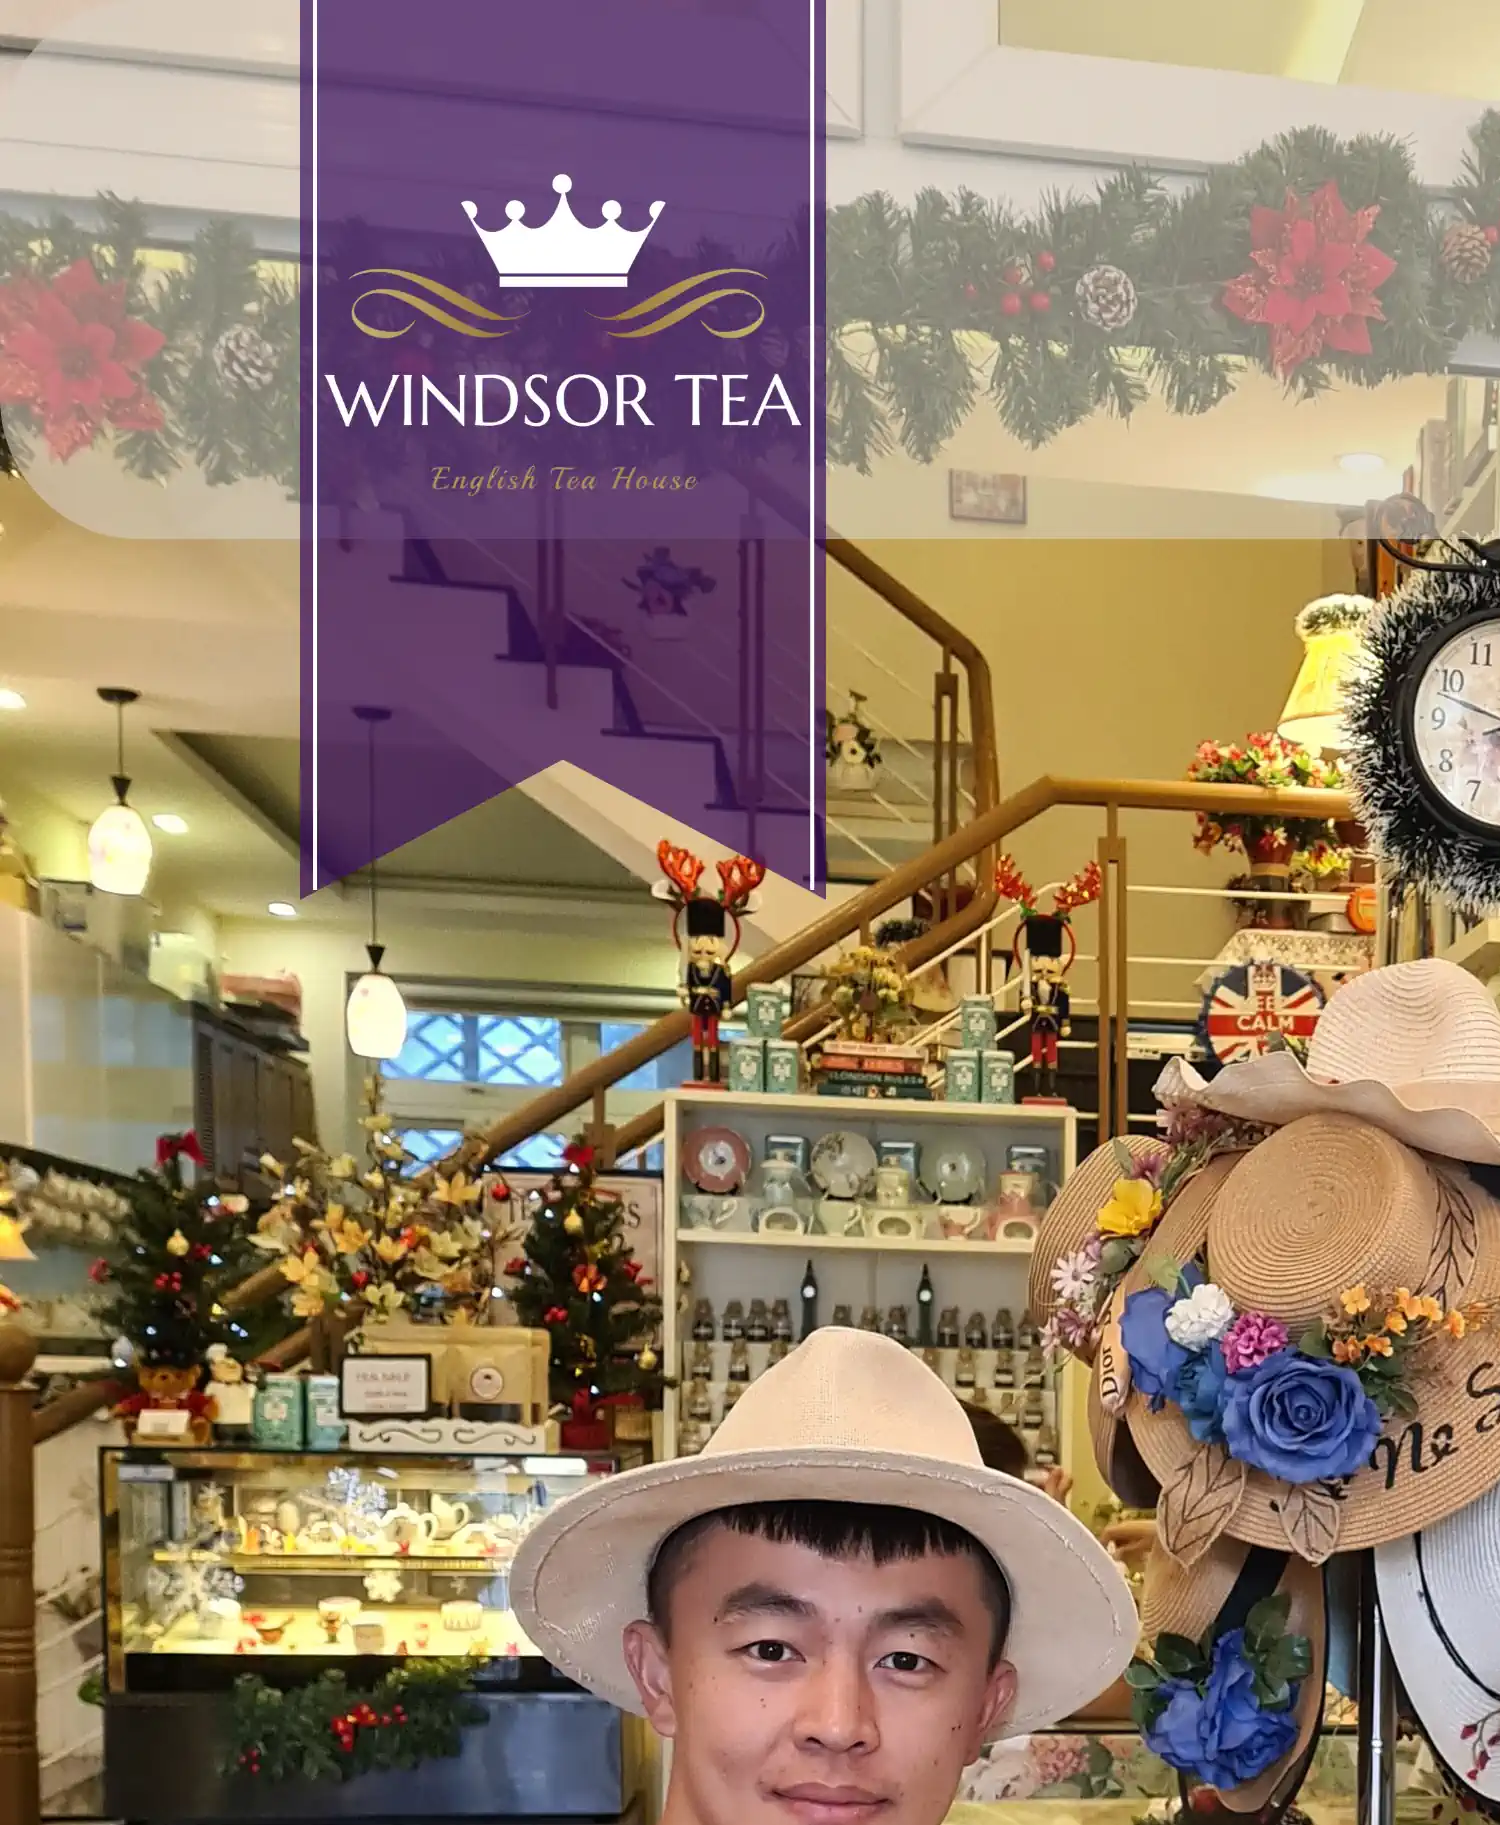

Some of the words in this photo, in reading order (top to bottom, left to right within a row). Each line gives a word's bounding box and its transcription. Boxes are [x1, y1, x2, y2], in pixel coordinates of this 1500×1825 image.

[1469, 642, 1493, 667] 11
[1441, 669, 1465, 693] 10
[1431, 707, 1446, 731] 9
[1438, 748, 1453, 772] 8
[1465, 779, 1481, 802] 7
[1236, 1015, 1295, 1031] CALM
[1368, 1420, 1459, 1491] Ne
